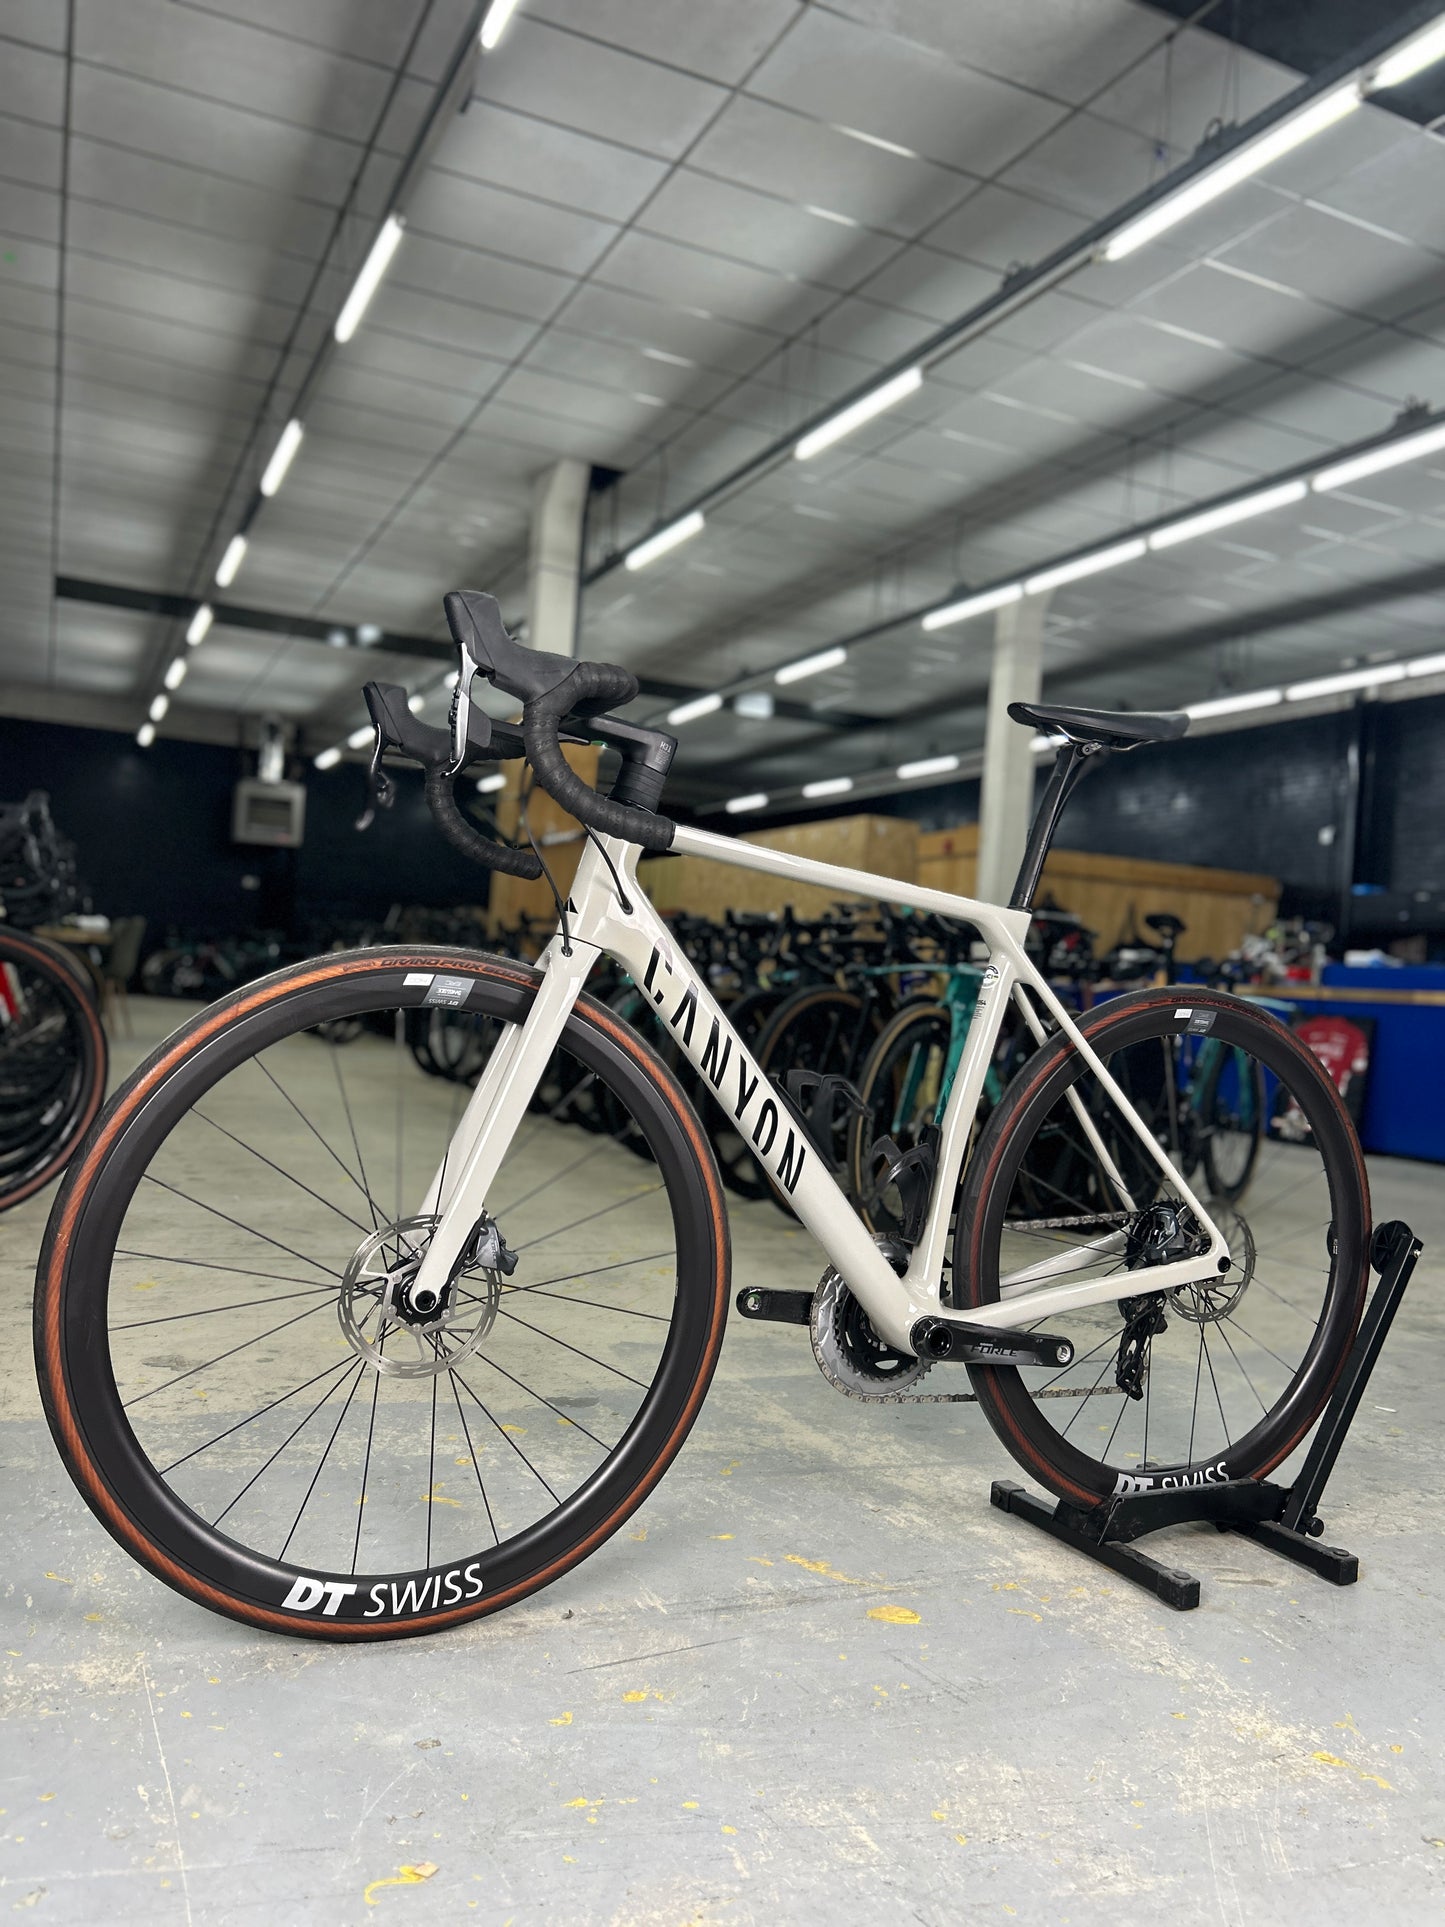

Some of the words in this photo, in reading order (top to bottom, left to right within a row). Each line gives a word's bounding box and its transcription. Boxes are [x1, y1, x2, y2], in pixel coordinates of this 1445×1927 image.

[380, 957, 440, 967] GRAND
[643, 937, 806, 1196] CANYON
[970, 1345, 1017, 1357] FORCE
[1111, 1473, 1154, 1496] DT
[280, 1575, 358, 1616] DT
[362, 1562, 484, 1617] SWISS
